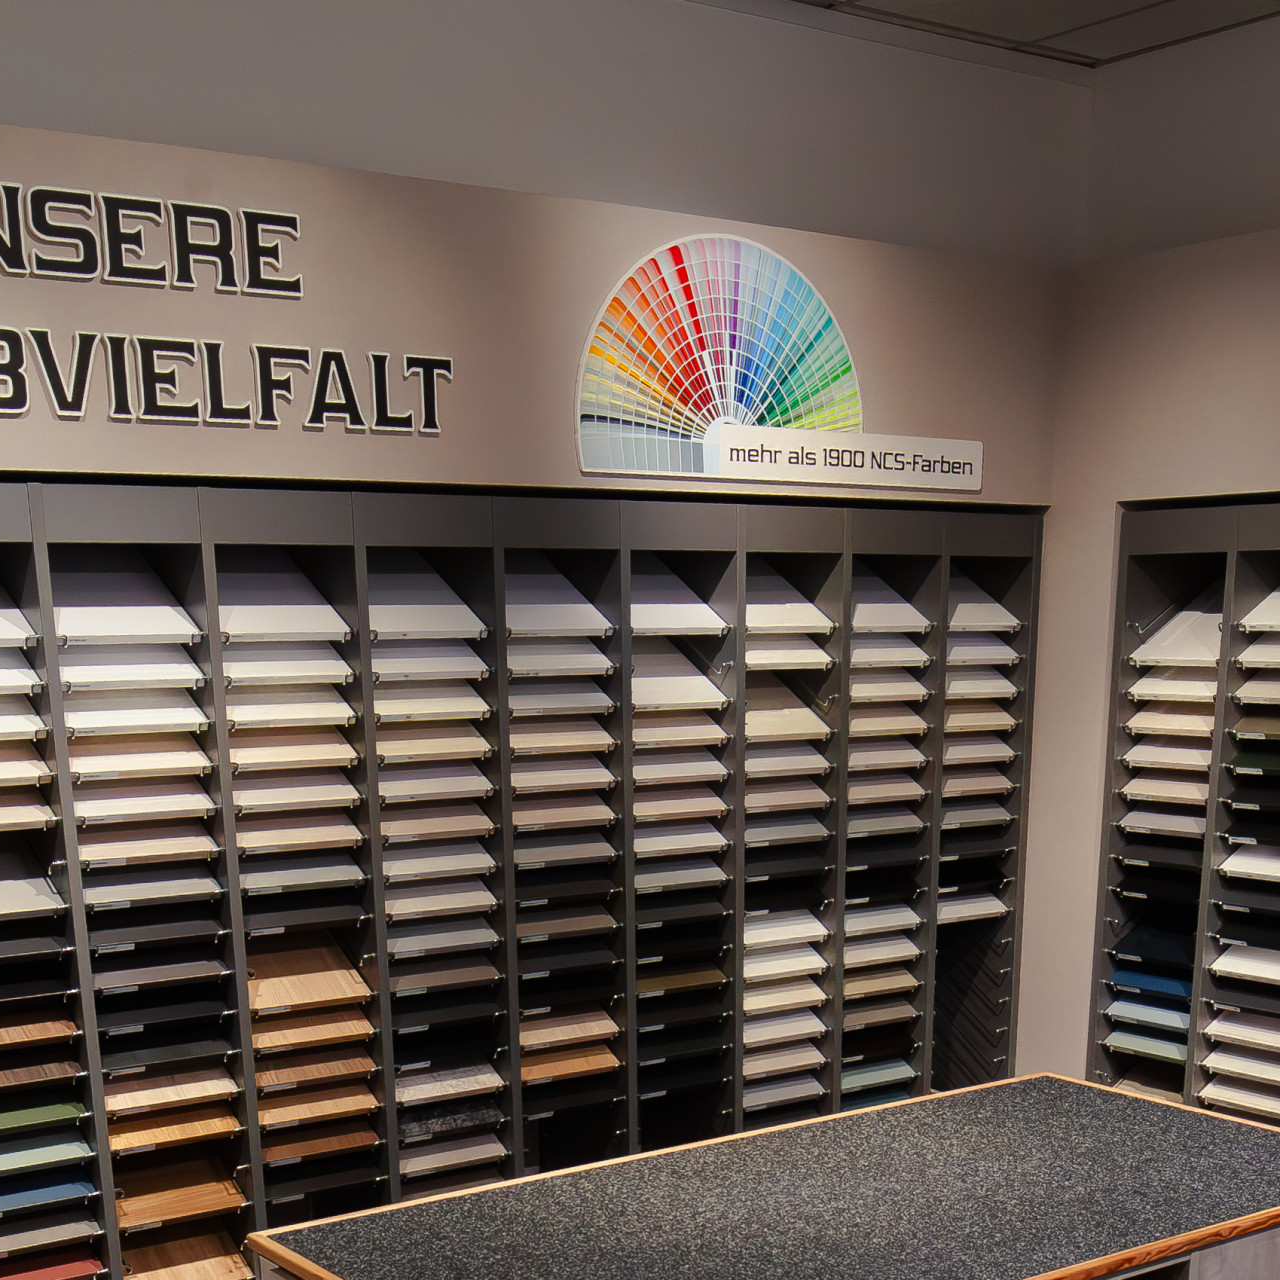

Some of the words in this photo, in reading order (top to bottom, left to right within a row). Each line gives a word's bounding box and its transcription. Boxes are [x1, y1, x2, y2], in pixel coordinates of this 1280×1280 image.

[729, 444, 782, 464] mehr
[788, 446, 817, 466] als
[823, 448, 865, 468] 1900
[870, 451, 973, 475] NCS-Farben
